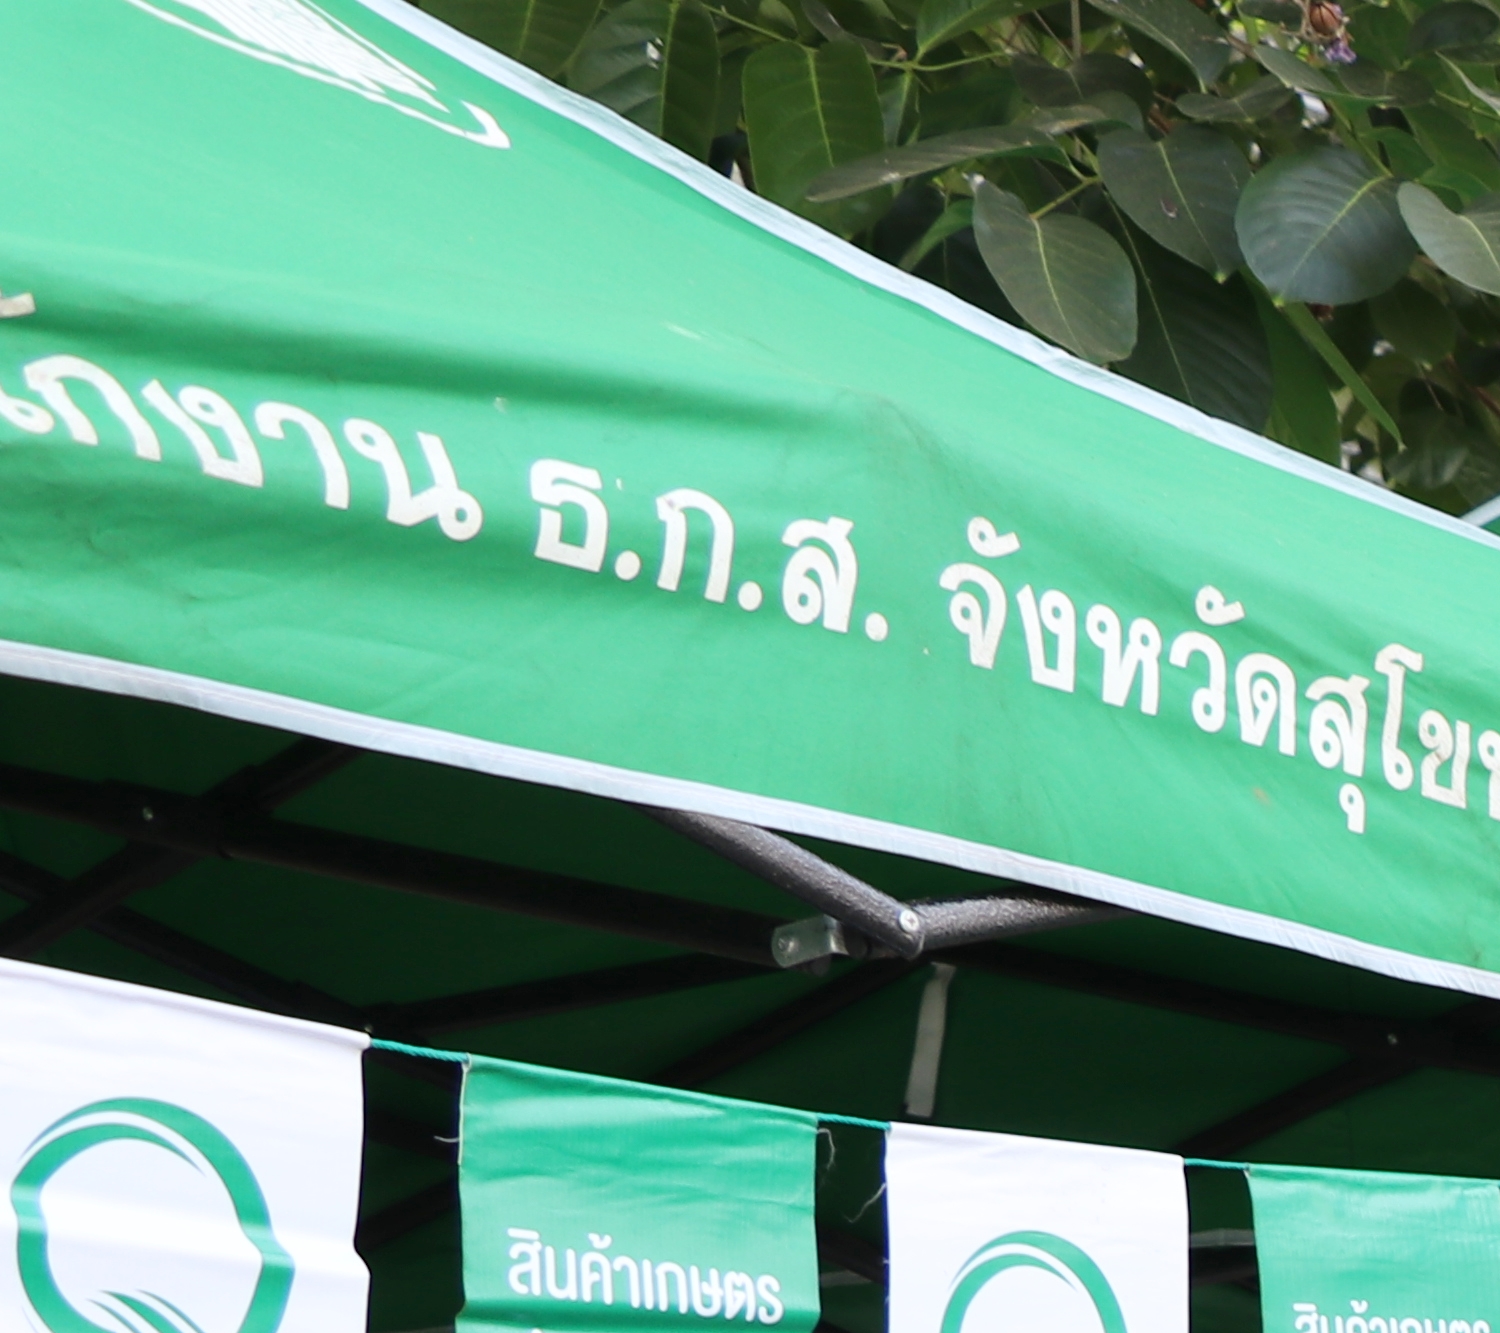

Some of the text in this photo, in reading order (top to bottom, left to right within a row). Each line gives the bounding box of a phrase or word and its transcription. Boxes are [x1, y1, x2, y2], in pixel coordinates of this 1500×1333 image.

[529, 456, 888, 642] ธ.ก.ส.
[507, 1227, 784, 1326] สินค้าเกษตร
